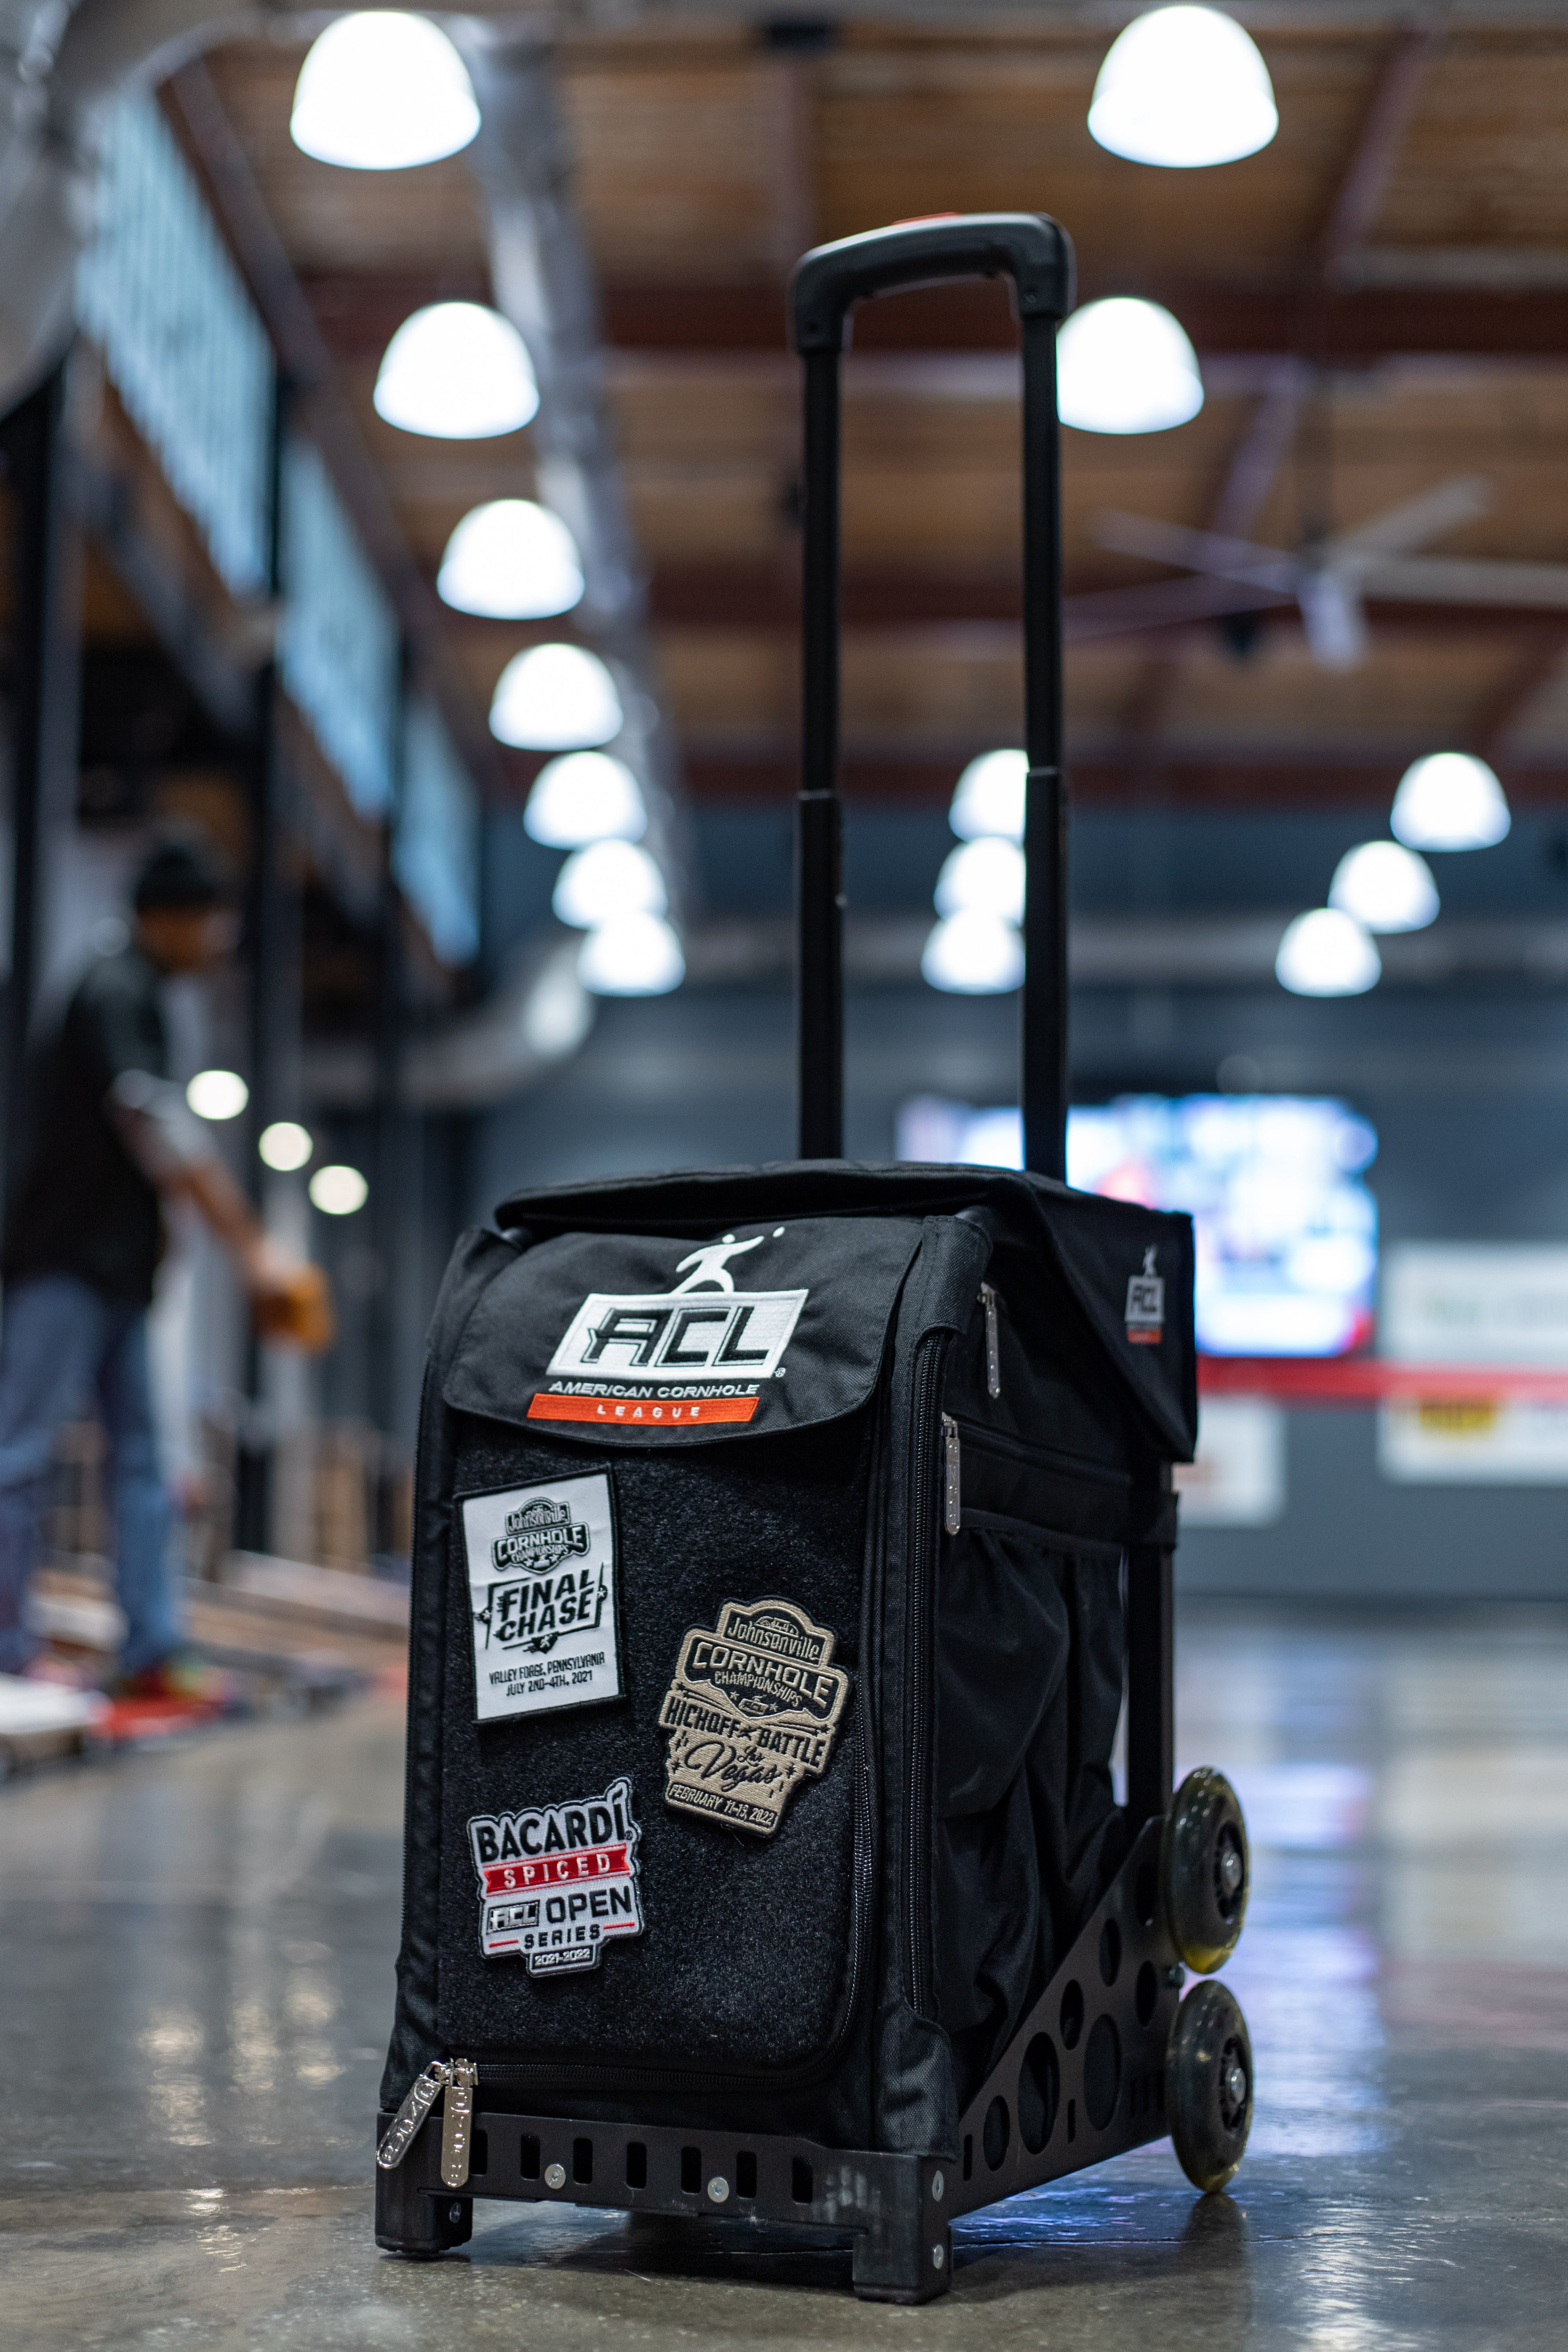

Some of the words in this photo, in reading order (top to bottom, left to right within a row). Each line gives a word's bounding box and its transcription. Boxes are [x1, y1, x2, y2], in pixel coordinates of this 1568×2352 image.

[581, 1306, 770, 1368] ACL
[549, 1380, 653, 1398] AMERICAN
[657, 1384, 760, 1398] CORNHOLE
[597, 1404, 700, 1418] LEAGUE
[509, 1505, 569, 1532] Johnsonville
[498, 1526, 584, 1561] CORNHOLE
[511, 1544, 569, 1563] CHAMPIONSHIPS
[497, 1569, 594, 1622] FINAL
[493, 1588, 594, 1641] CHASE
[727, 1617, 820, 1661] Johnsonville
[489, 1668, 517, 1685] VALLEY
[519, 1662, 546, 1679] FORGE,
[547, 1651, 605, 1674] PENNSYLVANIA
[506, 1682, 525, 1696] JULY
[572, 1669, 593, 1685] 2021
[692, 1641, 834, 1709] CORNHOLE
[714, 1670, 803, 1707] CHAMPIONSHIPS
[756, 1726, 826, 1768] BATTLE
[684, 1740, 782, 1792] Vegas
[668, 1784, 723, 1809] FEBRUARY
[724, 1799, 749, 1821] 11-13,
[749, 1808, 775, 1826] 2022
[504, 1854, 611, 1889] SPICED
[490, 1905, 536, 1931] ACL
[545, 1886, 632, 1924] OPEN
[524, 1923, 600, 1950] SERIES
[534, 1948, 590, 1966] 2021-2022
